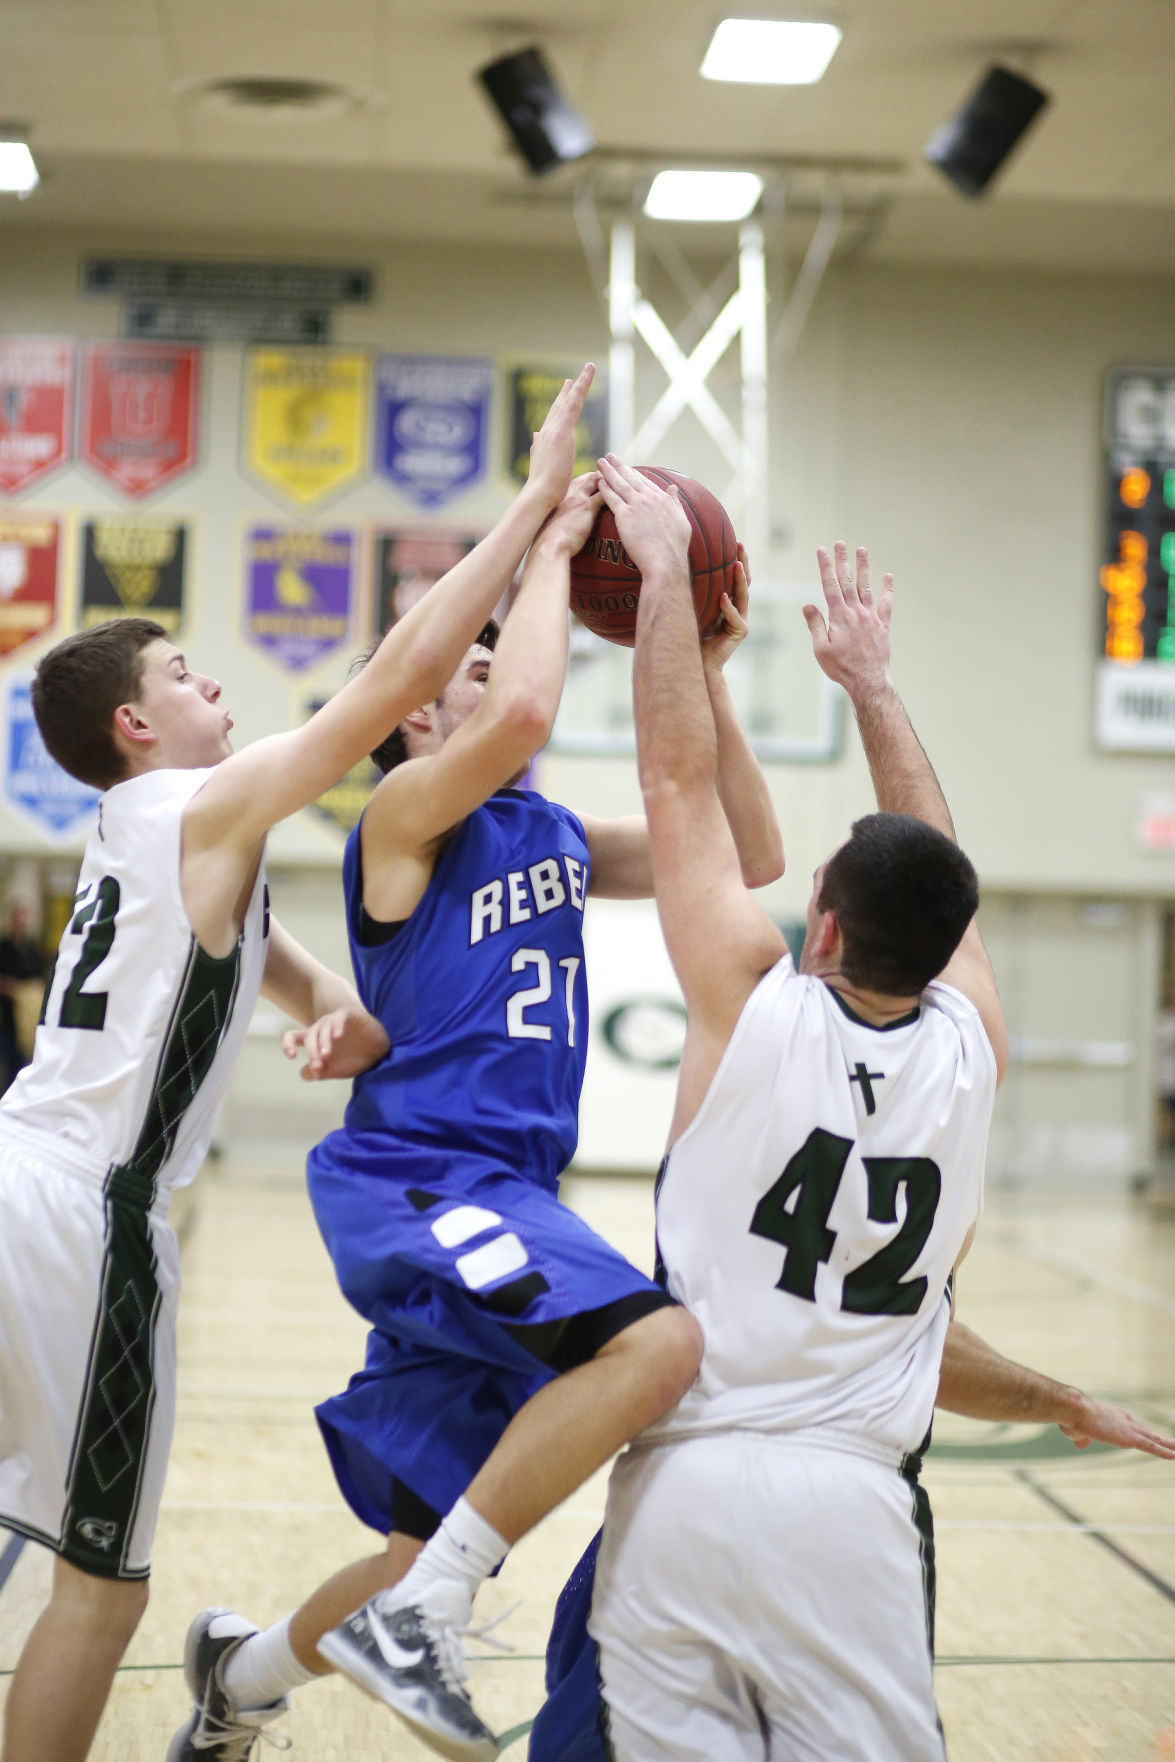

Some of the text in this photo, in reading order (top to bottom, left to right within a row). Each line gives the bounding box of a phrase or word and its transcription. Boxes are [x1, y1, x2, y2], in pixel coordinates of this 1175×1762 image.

[37, 874, 121, 1031] 2
[506, 947, 581, 1048] 21
[748, 1126, 942, 1316] 42
